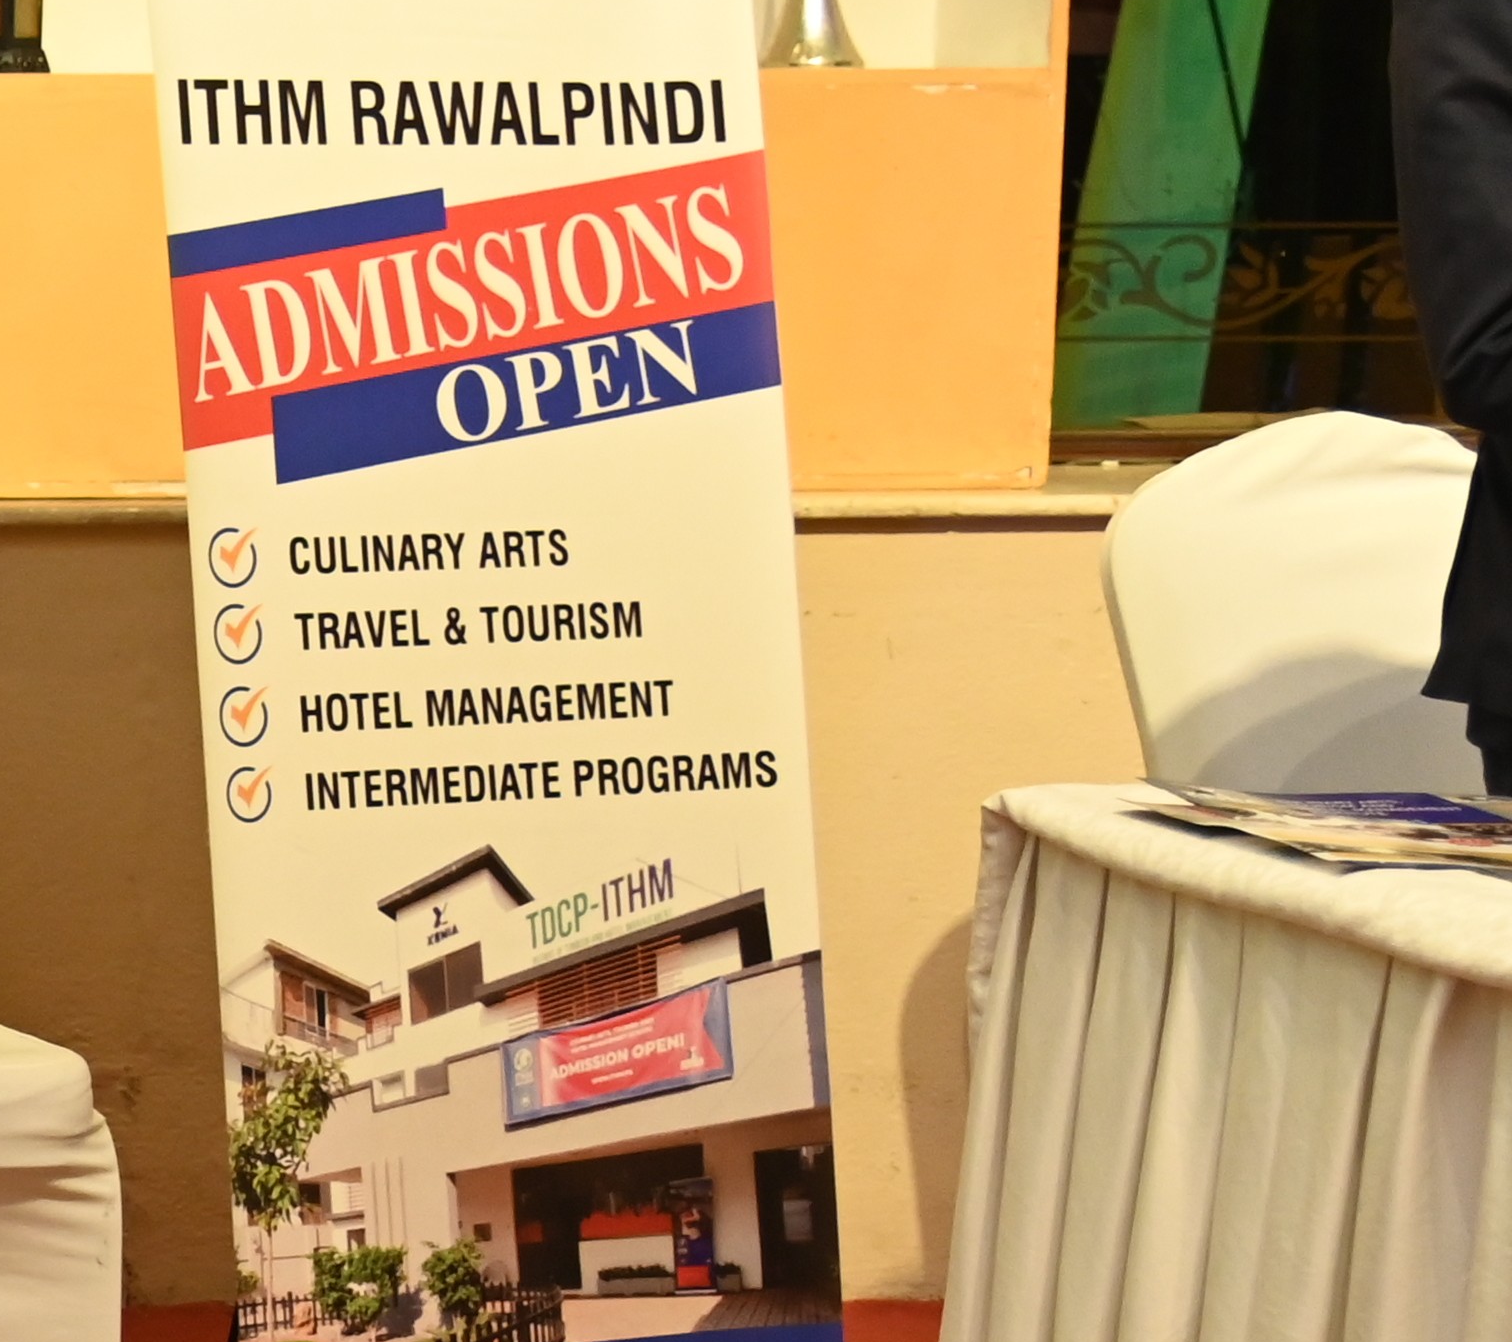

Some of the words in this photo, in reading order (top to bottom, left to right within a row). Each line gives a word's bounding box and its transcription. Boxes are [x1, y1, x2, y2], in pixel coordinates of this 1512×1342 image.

[178, 79, 327, 145] ITHM
[351, 80, 726, 145] RAWALPINDI
[195, 185, 743, 404] ADMISSIONS
[436, 320, 698, 443] OPEN
[290, 533, 464, 574] CULINARY
[480, 529, 568, 568] ARTS
[294, 609, 430, 650] TRAVEL
[445, 607, 467, 645] &
[480, 601, 642, 643] TOURISM
[300, 692, 413, 732] HOTEL
[426, 680, 673, 727] MANAGEMENT
[306, 761, 561, 810] INTERMEDIATE
[574, 751, 777, 796] PROGRAMS
[526, 857, 675, 949] TDCP-ITHM
[550, 1048, 629, 1079] ADMISSION
[631, 1032, 685, 1059] OPEN!
